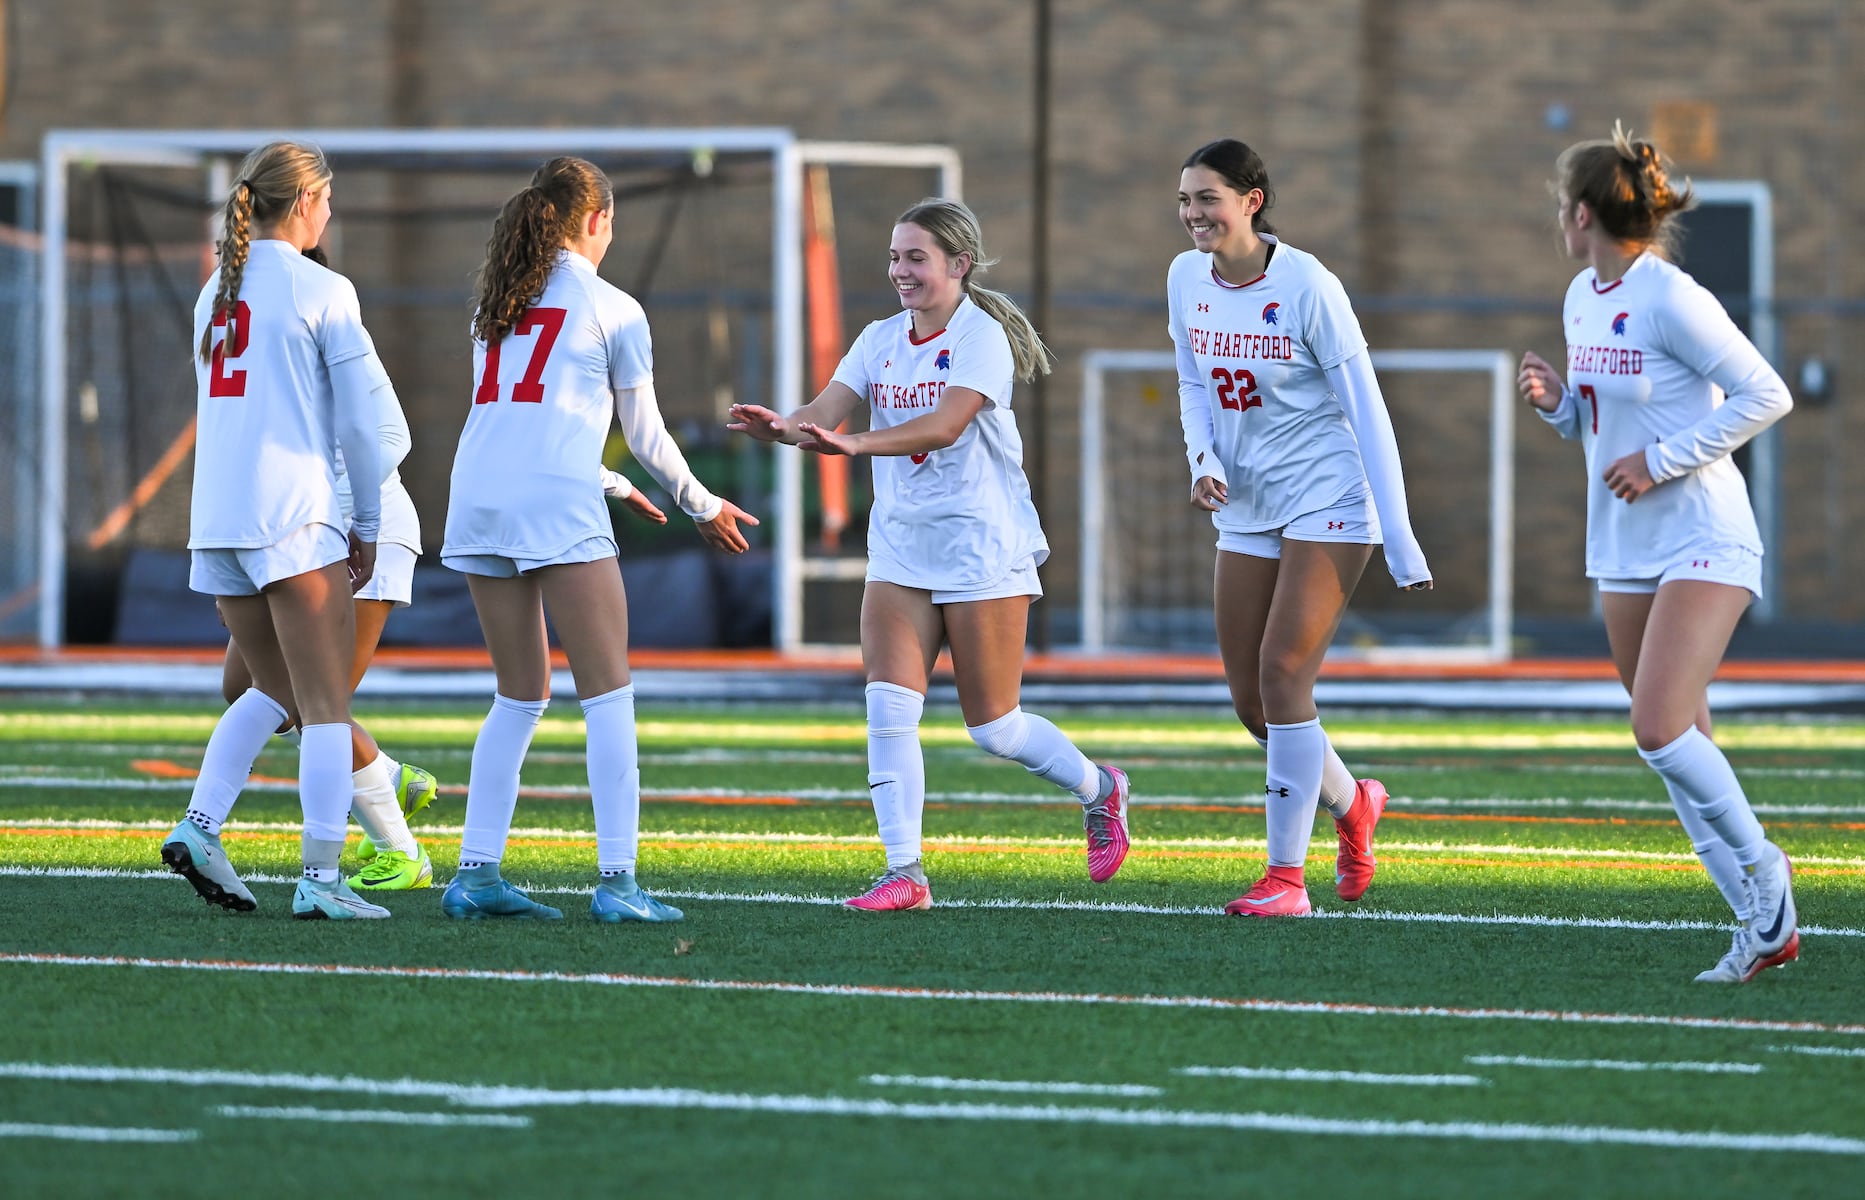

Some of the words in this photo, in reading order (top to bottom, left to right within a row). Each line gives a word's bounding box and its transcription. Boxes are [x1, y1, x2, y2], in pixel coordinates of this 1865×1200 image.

[209, 300, 251, 398] 2
[475, 307, 567, 404] 17
[1188, 327, 1210, 355] NEW
[1212, 331, 1292, 360] HARTFORD
[1573, 344, 1643, 375] HARTFORD
[892, 381, 946, 409] HARTFO
[1211, 367, 1263, 412] 22
[1578, 384, 1598, 435] 7
